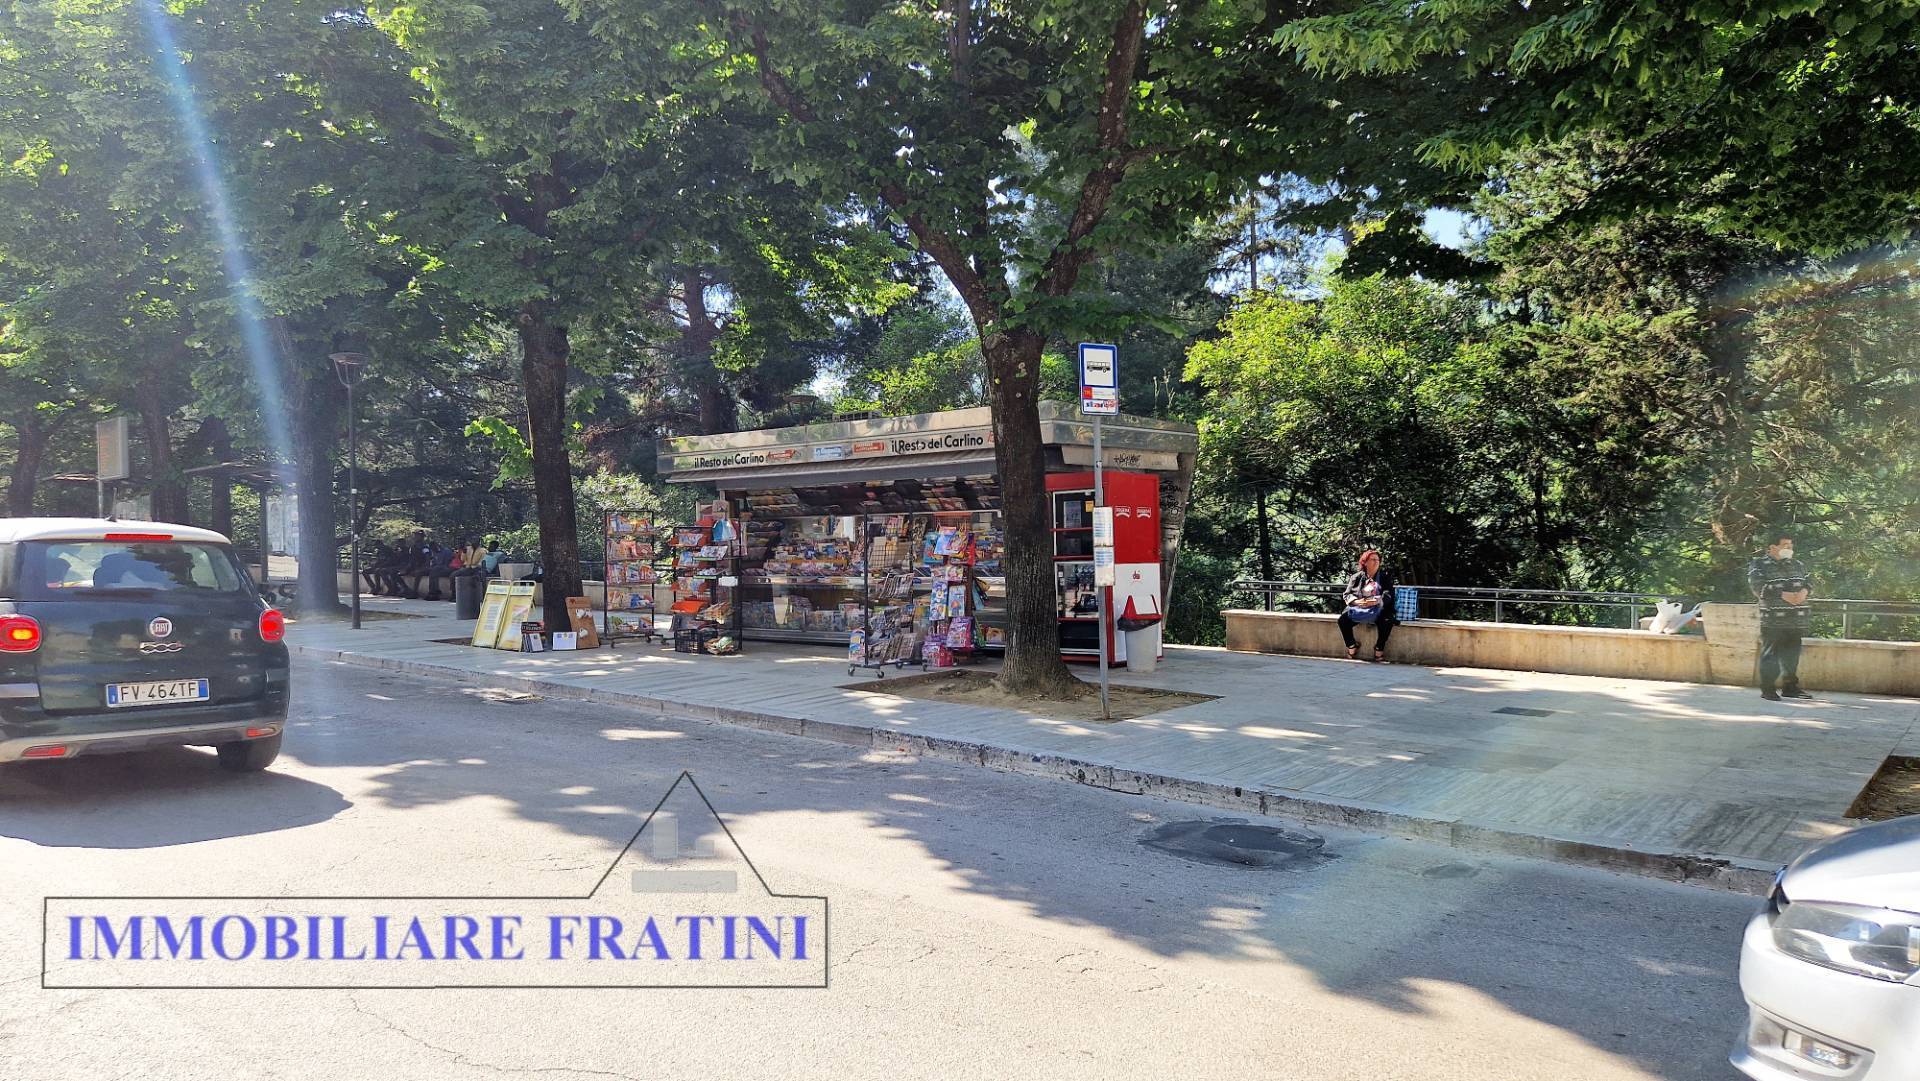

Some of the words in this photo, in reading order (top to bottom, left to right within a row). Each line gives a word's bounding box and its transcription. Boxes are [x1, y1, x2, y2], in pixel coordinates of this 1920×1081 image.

[891, 440, 897, 453] il
[898, 438, 926, 452] Resto
[927, 437, 943, 449] del
[944, 433, 984, 448] Carlino
[694, 458, 700, 469] il
[700, 456, 722, 468] Resto
[722, 455, 734, 466] del
[734, 452, 764, 465] Carlino
[155, 622, 169, 634] FIAT
[120, 685, 141, 701] FV
[147, 681, 197, 699] 464TF
